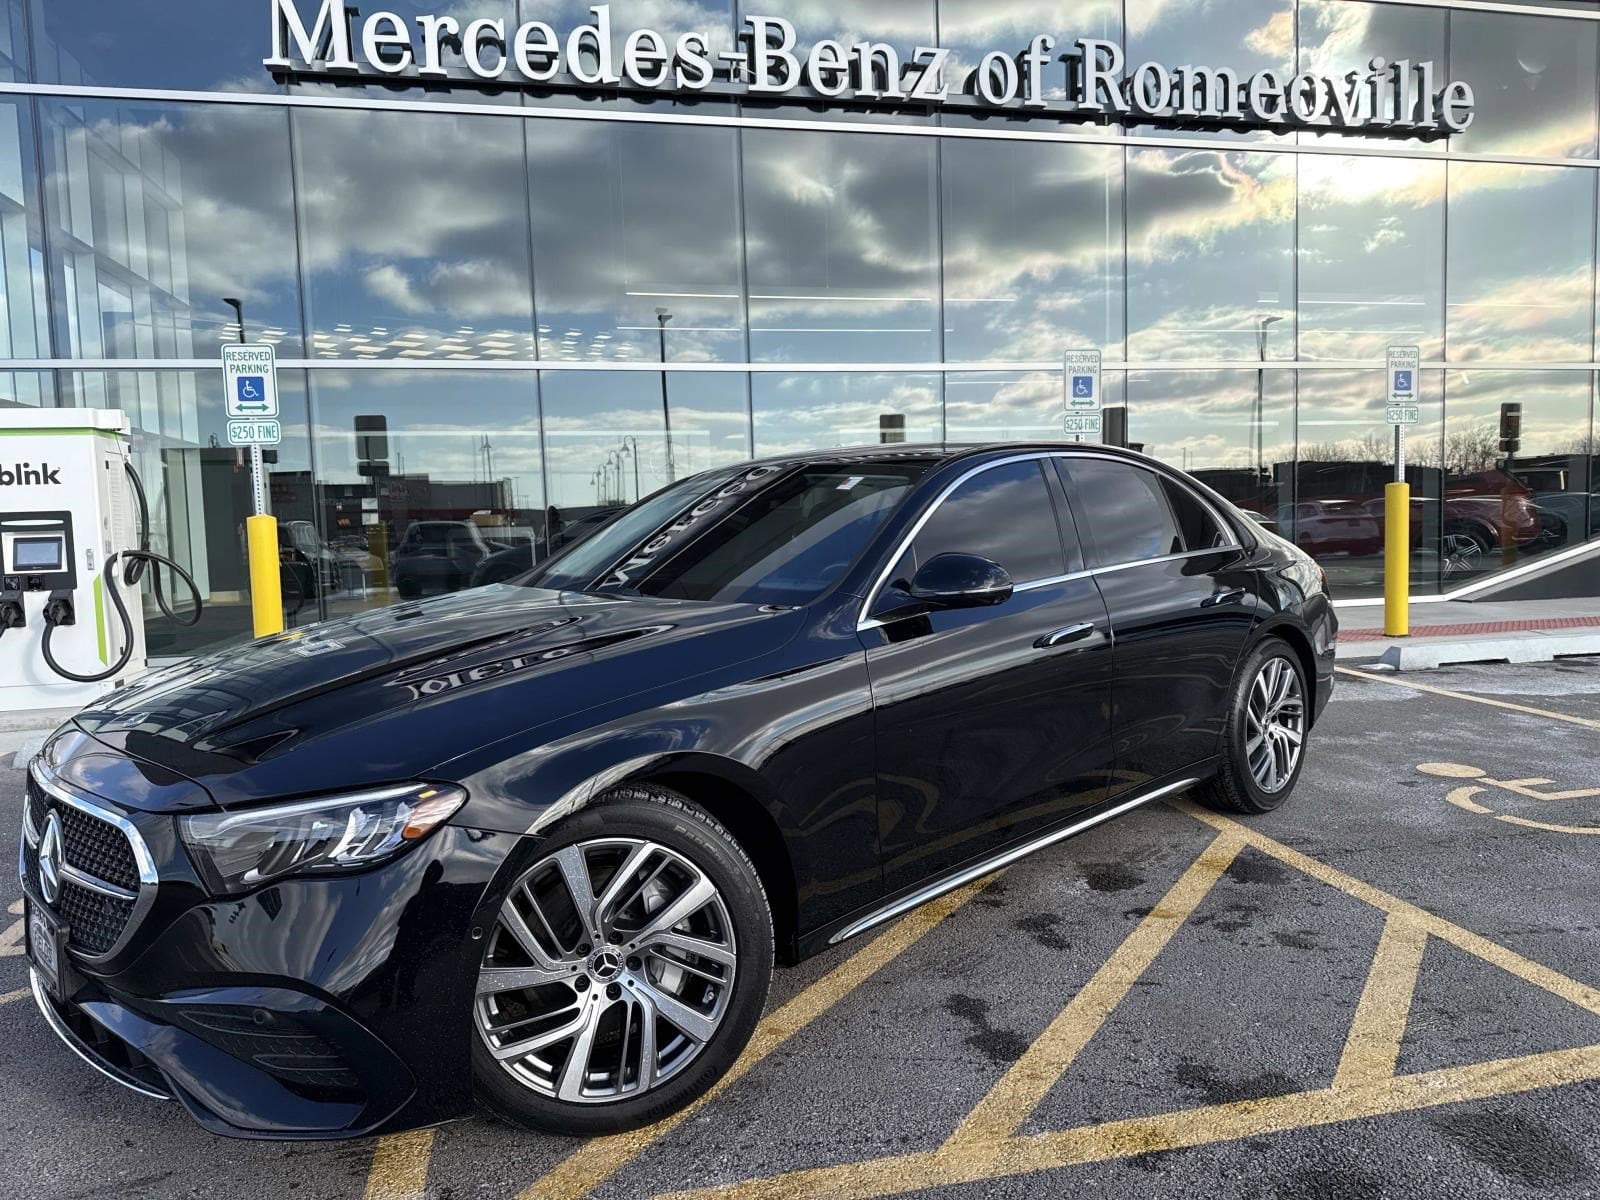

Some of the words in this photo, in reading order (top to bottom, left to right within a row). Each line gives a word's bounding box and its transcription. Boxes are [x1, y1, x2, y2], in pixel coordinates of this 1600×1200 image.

[262, 0, 950, 102] Mercedes-Benz
[978, 34, 1056, 109] of
[1077, 38, 1476, 134] Romeoville
[225, 351, 271, 361] RESERVED
[1066, 354, 1099, 364] RESERVED
[1388, 350, 1418, 359] RESERVED
[229, 364, 269, 374] PARKING
[1068, 365, 1097, 375] PARKING
[1390, 361, 1416, 369] PARKING
[1387, 409, 1404, 421] $250
[1405, 410, 1417, 421] FINE
[1065, 418, 1083, 431] $250
[1084, 417, 1099, 430] FINE
[231, 426, 255, 439] $250
[258, 425, 277, 439] FINE
[0, 462, 62, 486] blink
